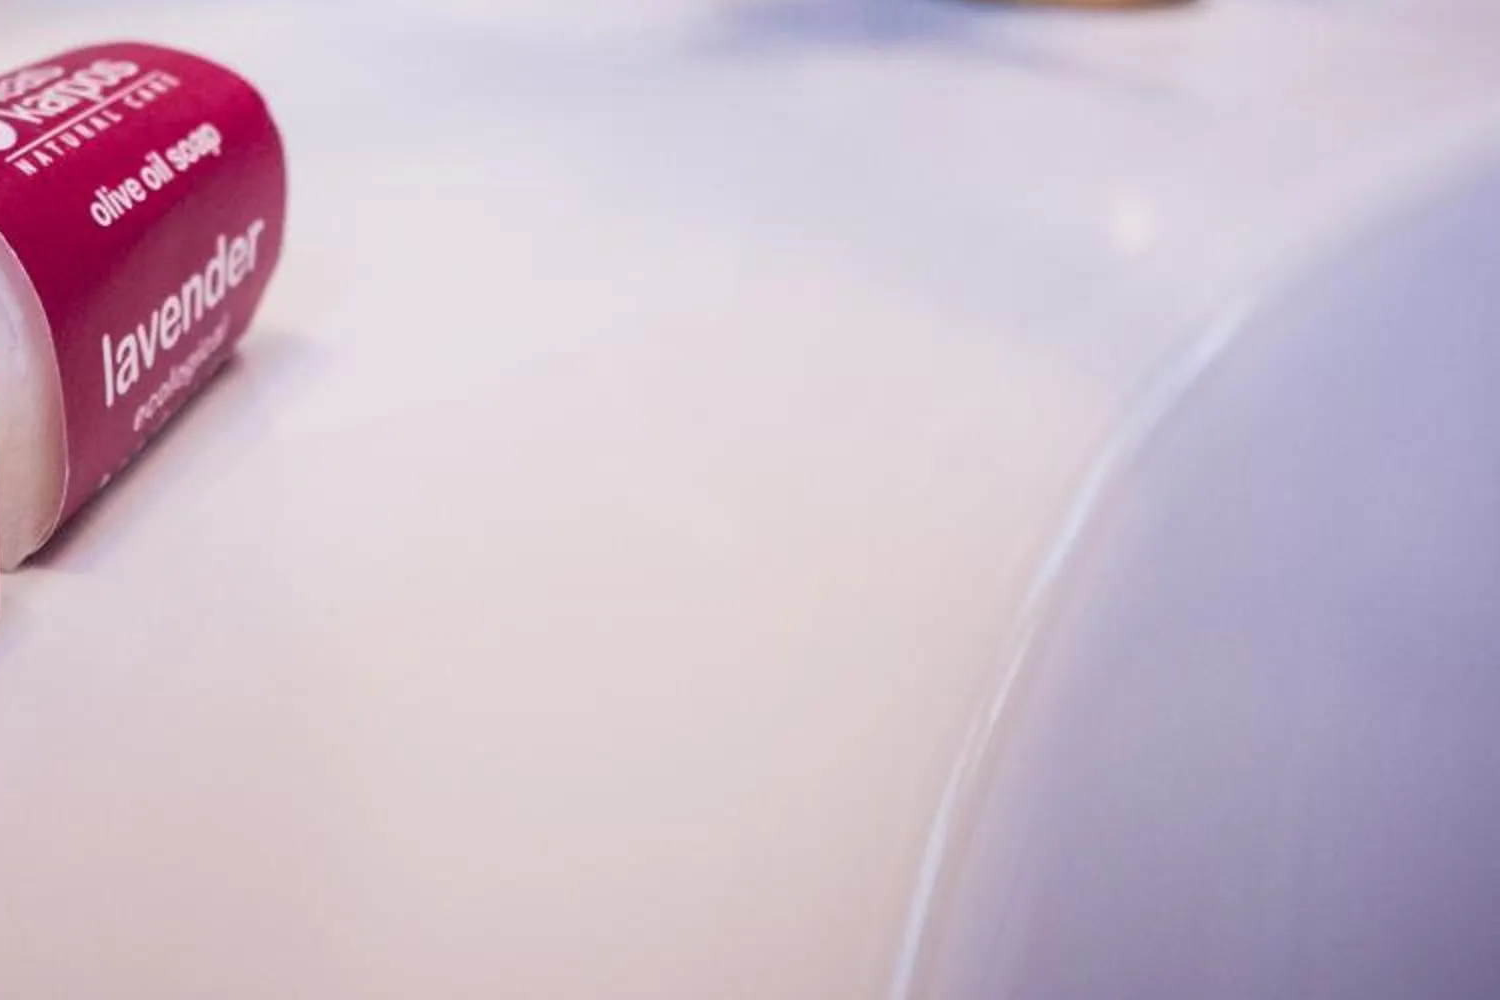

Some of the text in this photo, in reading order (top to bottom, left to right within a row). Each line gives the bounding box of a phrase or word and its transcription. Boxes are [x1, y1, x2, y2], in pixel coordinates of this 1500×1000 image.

[13, 109, 123, 176] NATURAL
[89, 121, 223, 228] olive oil soap
[102, 219, 265, 408] lavender
